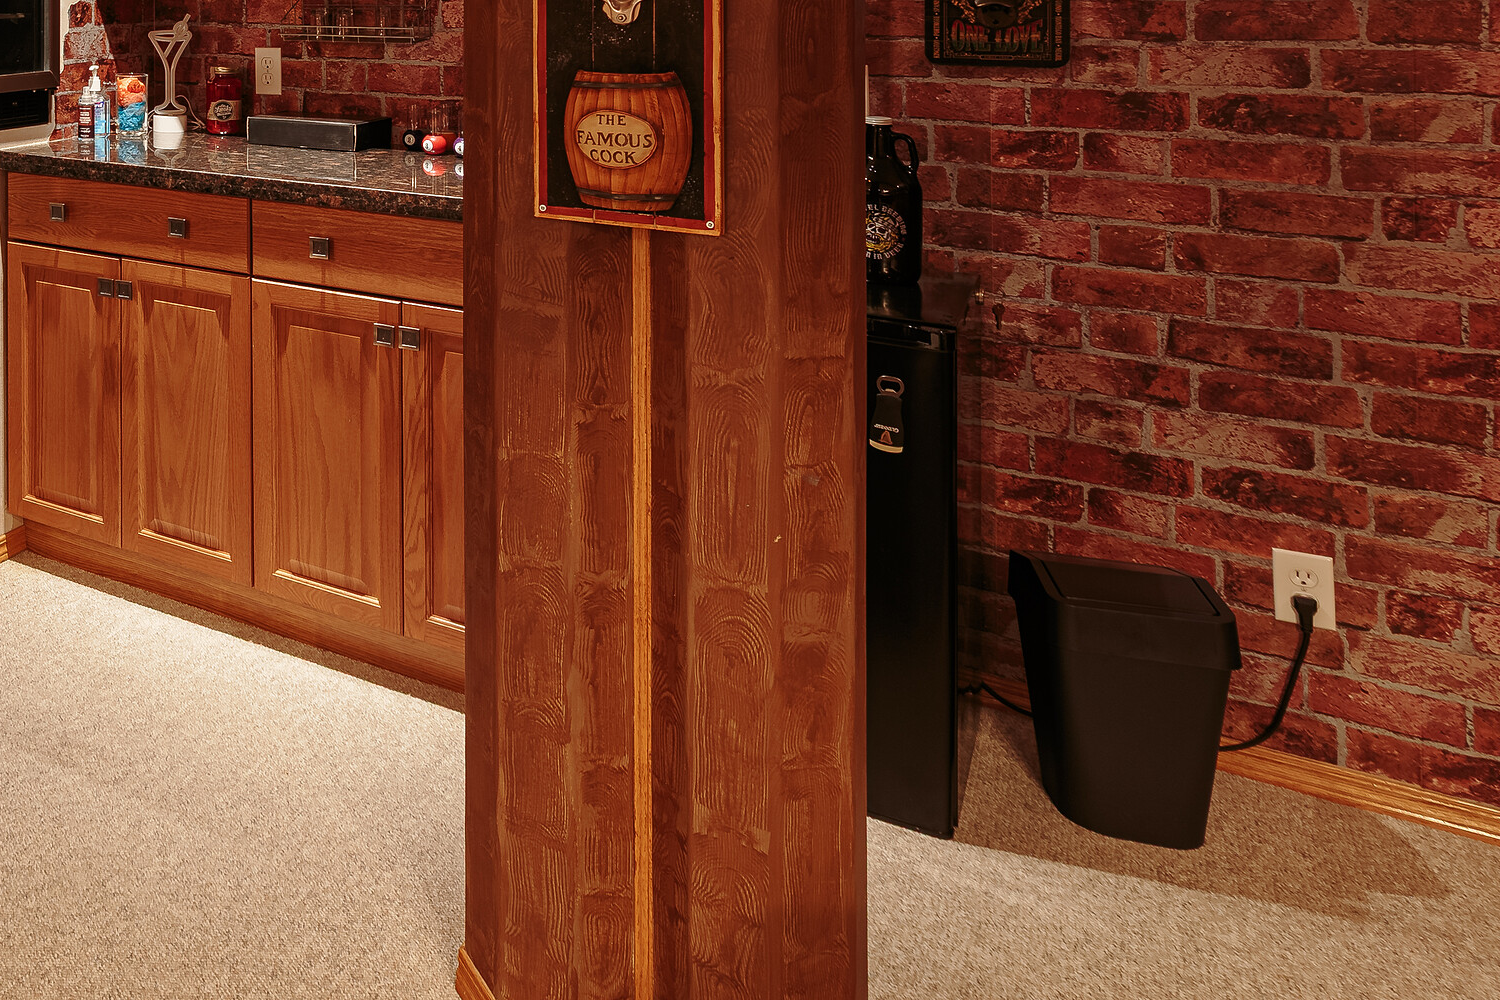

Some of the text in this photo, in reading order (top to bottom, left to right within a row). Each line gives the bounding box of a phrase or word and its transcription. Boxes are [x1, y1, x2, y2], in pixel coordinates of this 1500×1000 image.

[951, 18, 1045, 53] ONE LOVE
[596, 113, 626, 126] THE
[577, 130, 653, 148] FAMOUS
[590, 149, 638, 165] COCK
